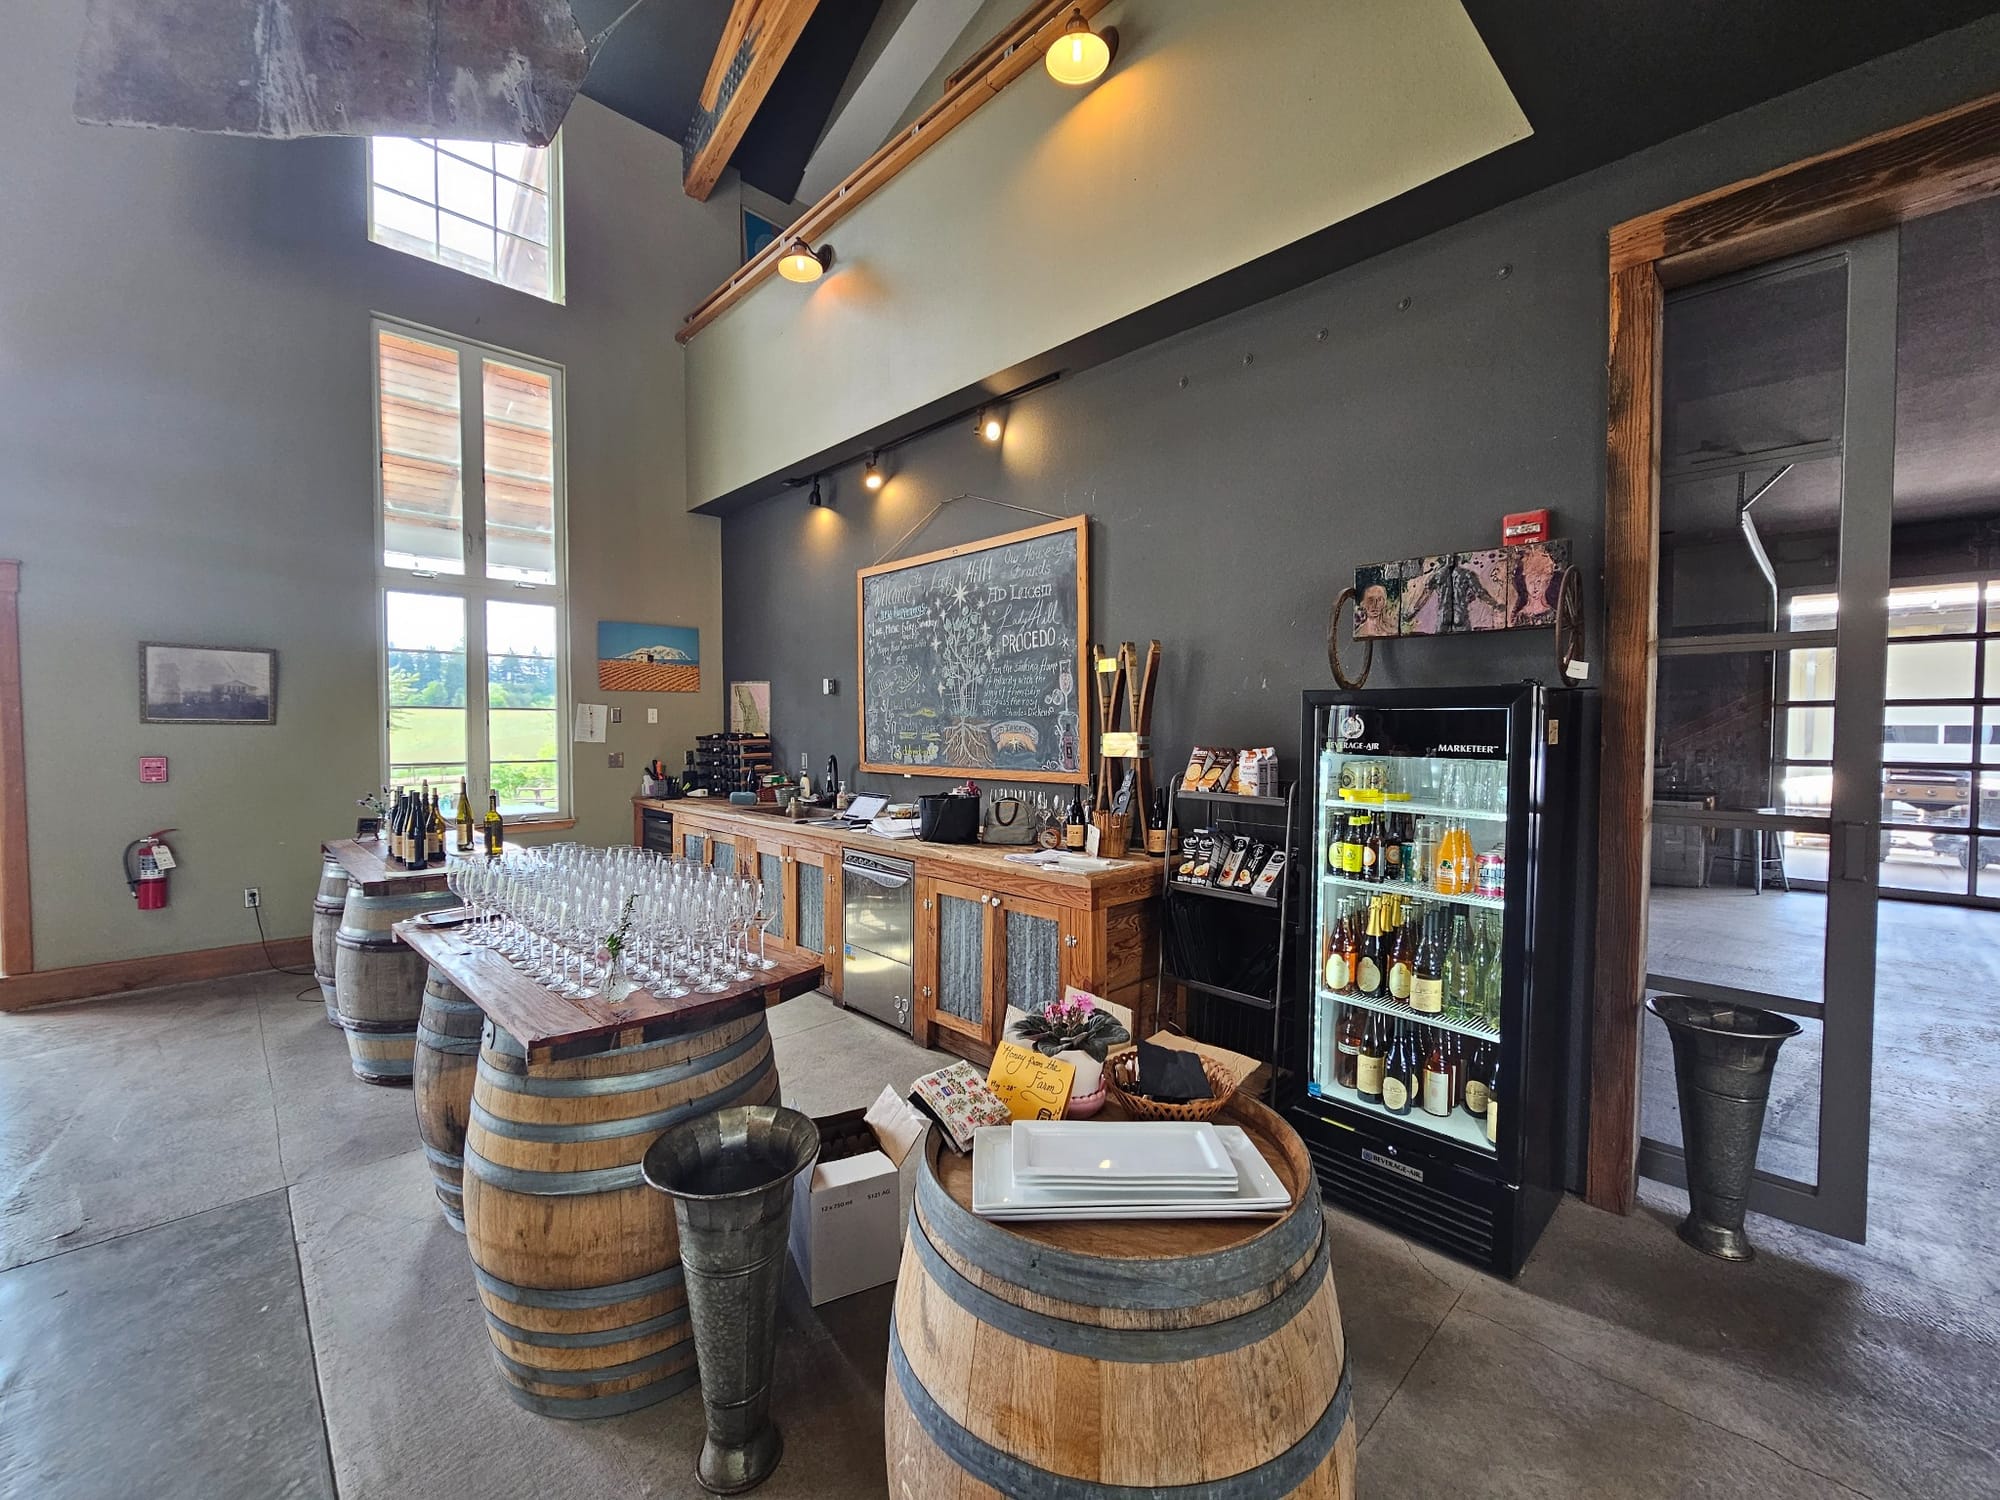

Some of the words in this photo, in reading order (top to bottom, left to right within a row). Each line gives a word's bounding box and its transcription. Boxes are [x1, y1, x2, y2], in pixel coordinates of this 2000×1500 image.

[930, 567, 955, 597] Lady
[964, 555, 993, 583] Hill!
[1002, 627, 1056, 654] PROCEDO
[1003, 1044, 1028, 1074] Honey
[1025, 1056, 1043, 1069] from
[1044, 1060, 1061, 1072] the
[1026, 1071, 1064, 1095] Farm
[1374, 1155, 1421, 1178] BEVERAGE-AIR
